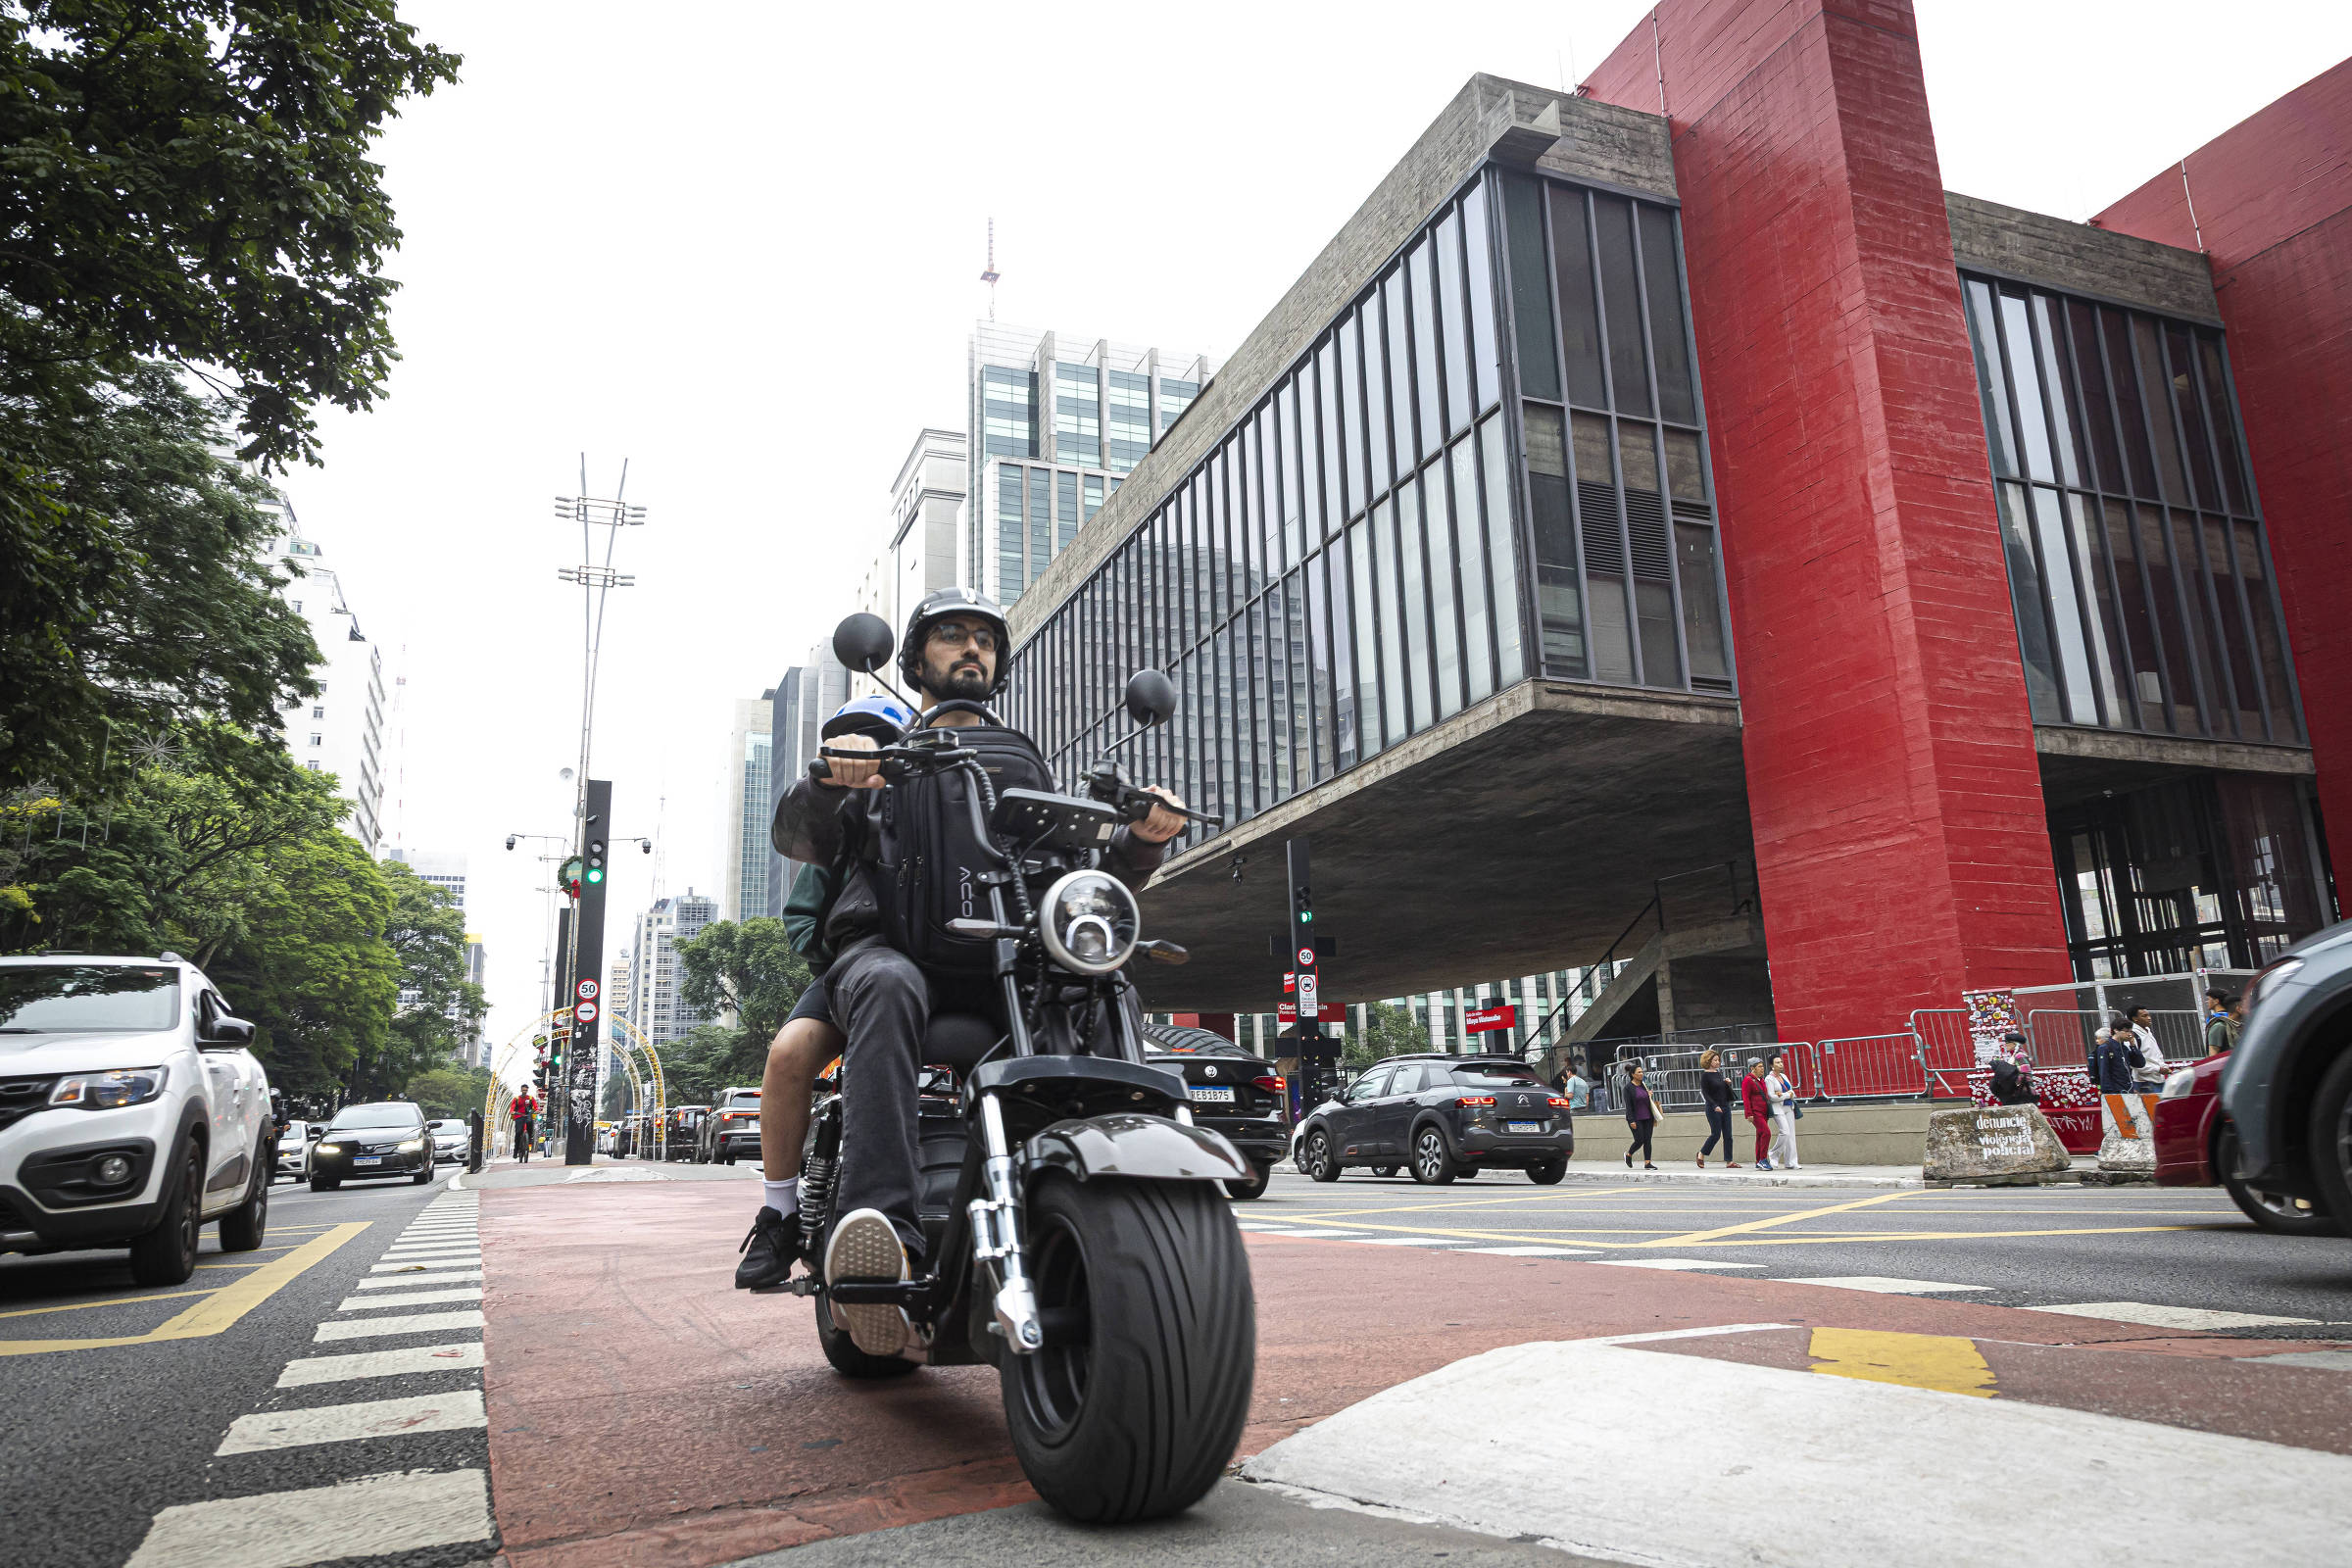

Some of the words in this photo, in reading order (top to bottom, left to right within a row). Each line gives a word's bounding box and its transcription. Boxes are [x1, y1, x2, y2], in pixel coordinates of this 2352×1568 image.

[581, 984, 595, 993] 50
[1976, 1114, 2027, 1130] denuncie
[1983, 1141, 2035, 1160] policial
